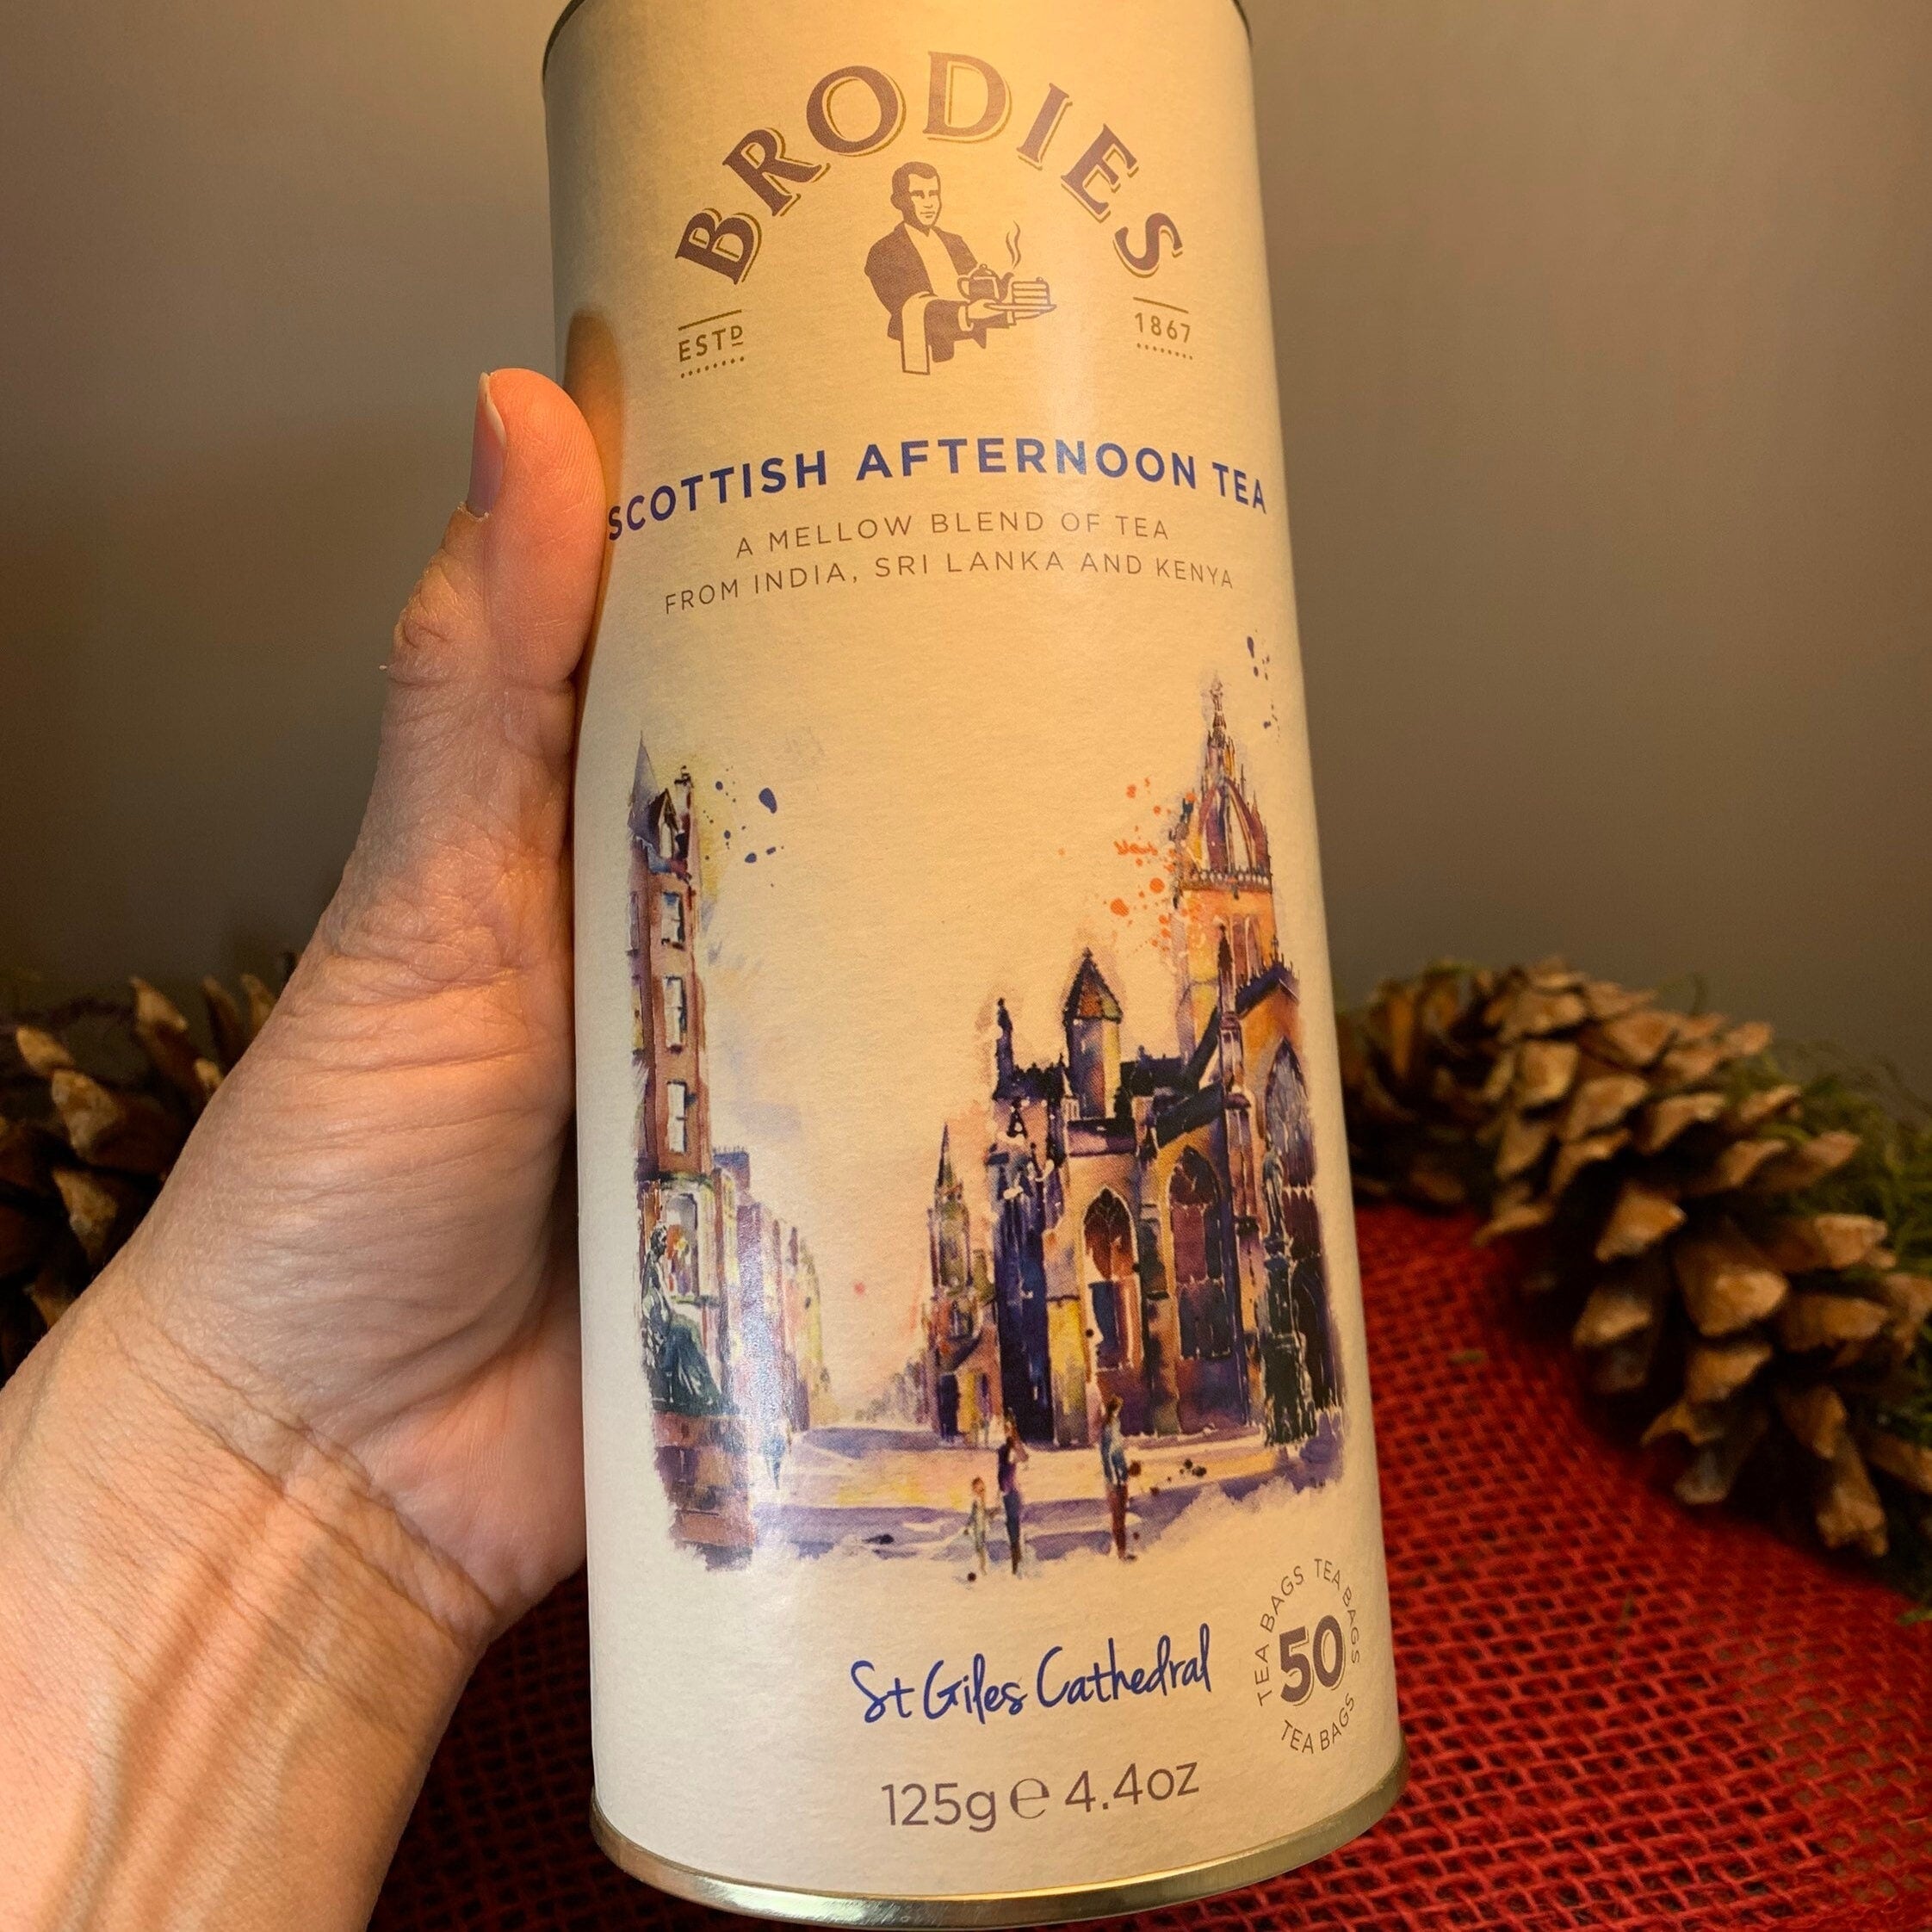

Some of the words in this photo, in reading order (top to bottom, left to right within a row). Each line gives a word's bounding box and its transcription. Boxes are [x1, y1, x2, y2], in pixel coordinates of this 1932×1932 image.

[675, 51, 1183, 285] BRODIES
[1135, 312, 1192, 344] 1867
[608, 450, 827, 541] SCOTTISH
[856, 437, 1198, 490] AFTERNOON
[1212, 461, 1268, 515] TEA
[736, 537, 753, 559] A
[769, 517, 912, 551] MELLOW
[932, 511, 1043, 534] BLEND
[1061, 511, 1101, 533] OF
[1115, 514, 1169, 540] TEA
[665, 580, 740, 615] FROM
[754, 562, 858, 595] INDIA,
[875, 554, 929, 579] SRI
[946, 550, 1064, 574] LANKA
[1081, 552, 1142, 576] AND
[1155, 556, 1234, 590] KENYA
[1260, 1565, 1304, 1633] BAGS
[1314, 1557, 1341, 1590] TEA
[1342, 1586, 1360, 1663] BAGS
[850, 1660, 915, 1724] St
[923, 1653, 1027, 1725] Giles
[1036, 1622, 1213, 1709] Cathedral
[1254, 1644, 1273, 1706] TEA
[1279, 1614, 1347, 1706] 50
[1281, 1719, 1314, 1754] TEA
[1319, 1693, 1355, 1751] BAGS
[881, 1780, 998, 1833] 125g
[1064, 1761, 1200, 1813] 4.4oz
